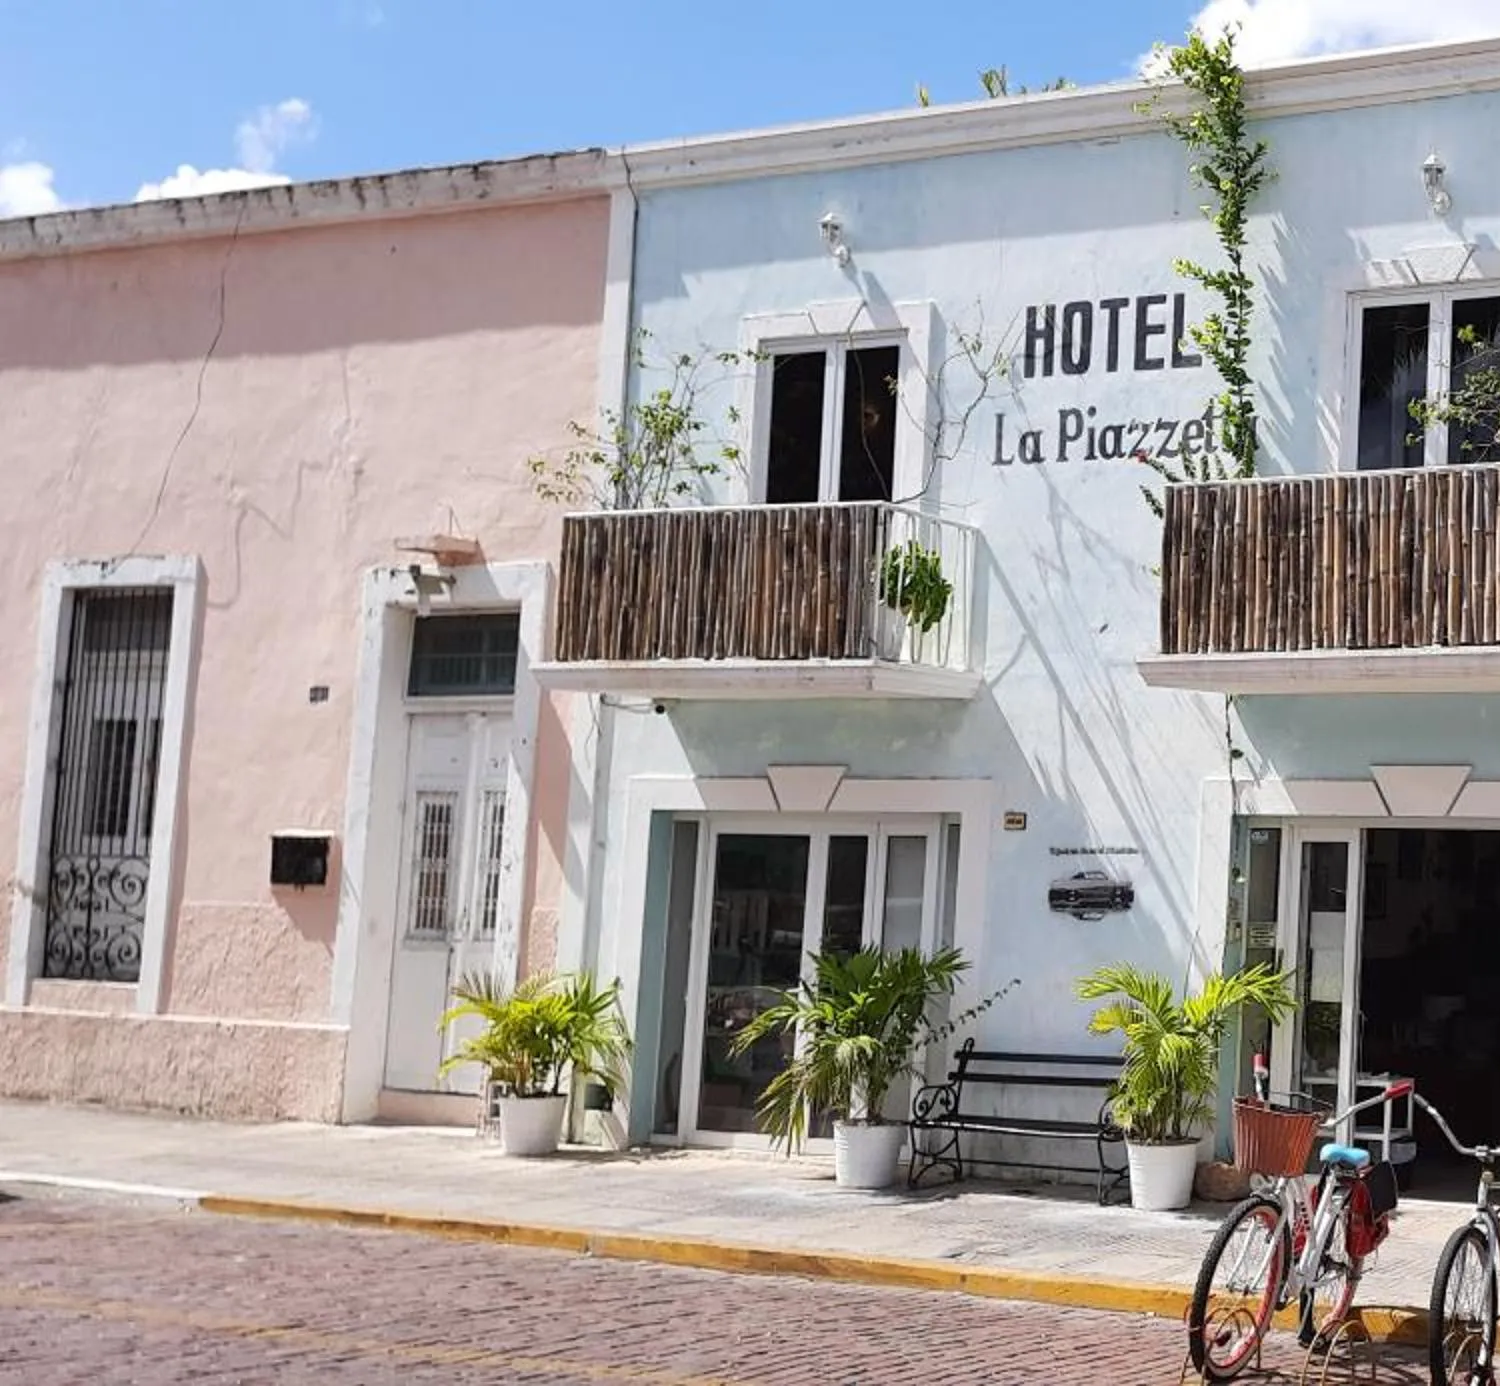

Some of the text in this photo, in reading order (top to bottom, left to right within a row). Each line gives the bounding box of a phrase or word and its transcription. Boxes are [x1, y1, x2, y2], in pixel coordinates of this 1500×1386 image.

[1023, 293, 1203, 378] HOTEL
[992, 398, 1260, 466] La Piazzet
